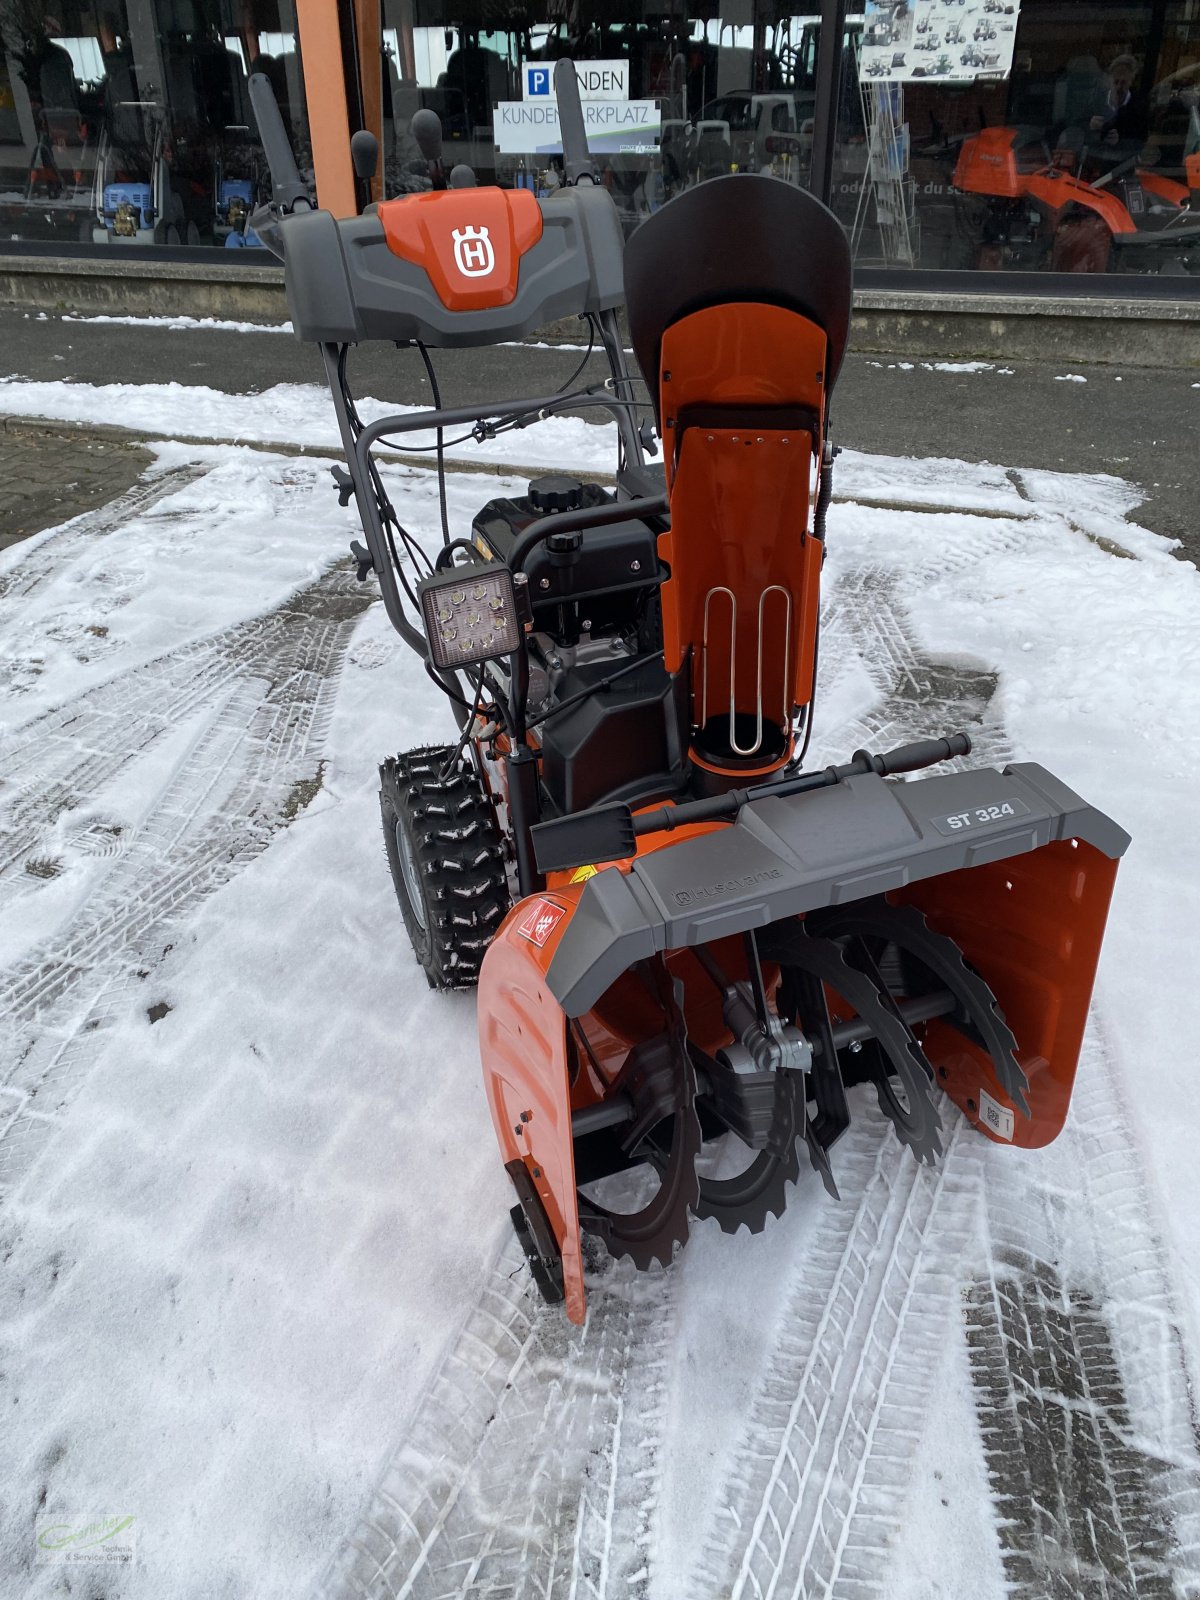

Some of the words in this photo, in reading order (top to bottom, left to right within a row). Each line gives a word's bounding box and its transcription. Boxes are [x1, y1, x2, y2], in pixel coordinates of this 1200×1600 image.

[533, 72, 545, 92] P
[553, 71, 623, 91] NDEN
[502, 106, 648, 124] KUNDERKPLATZ
[947, 813, 971, 829] ST
[975, 803, 1015, 822] 324
